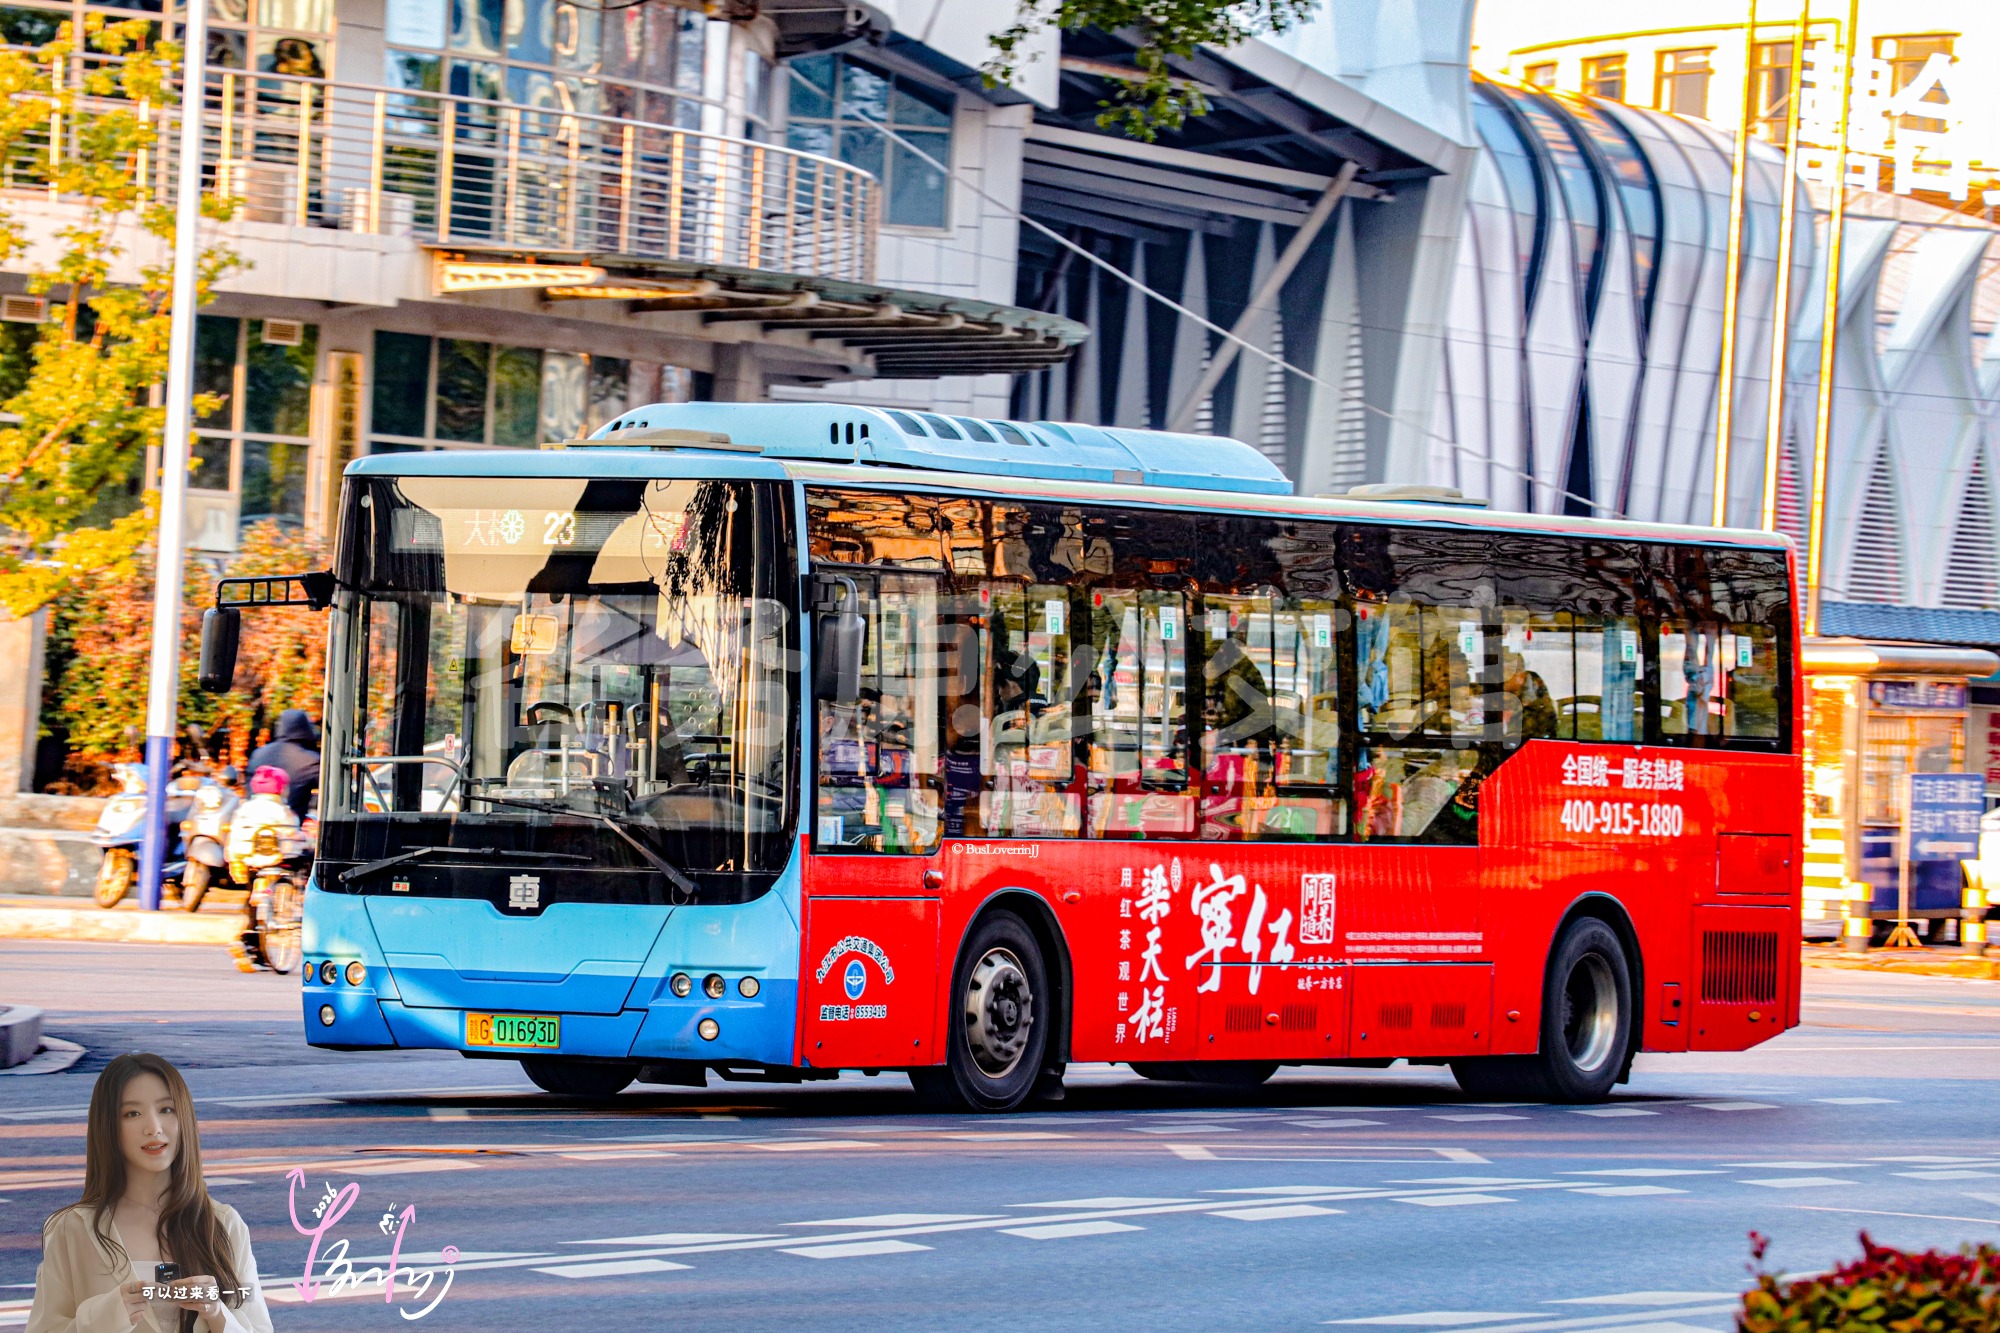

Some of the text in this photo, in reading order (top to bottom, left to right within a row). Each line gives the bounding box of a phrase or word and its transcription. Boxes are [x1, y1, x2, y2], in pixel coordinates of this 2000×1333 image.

[543, 511, 576, 546] 23
[1560, 753, 1684, 792] 全国统一服务热线
[1560, 799, 1684, 838] 400-915-1880
[816, 935, 895, 984] 九江市公共交通集团公司
[1115, 867, 1132, 1044] 用红茶观世界
[1128, 864, 1171, 1044] 梁天柱
[1164, 1007, 1172, 1044] TIANZHU
